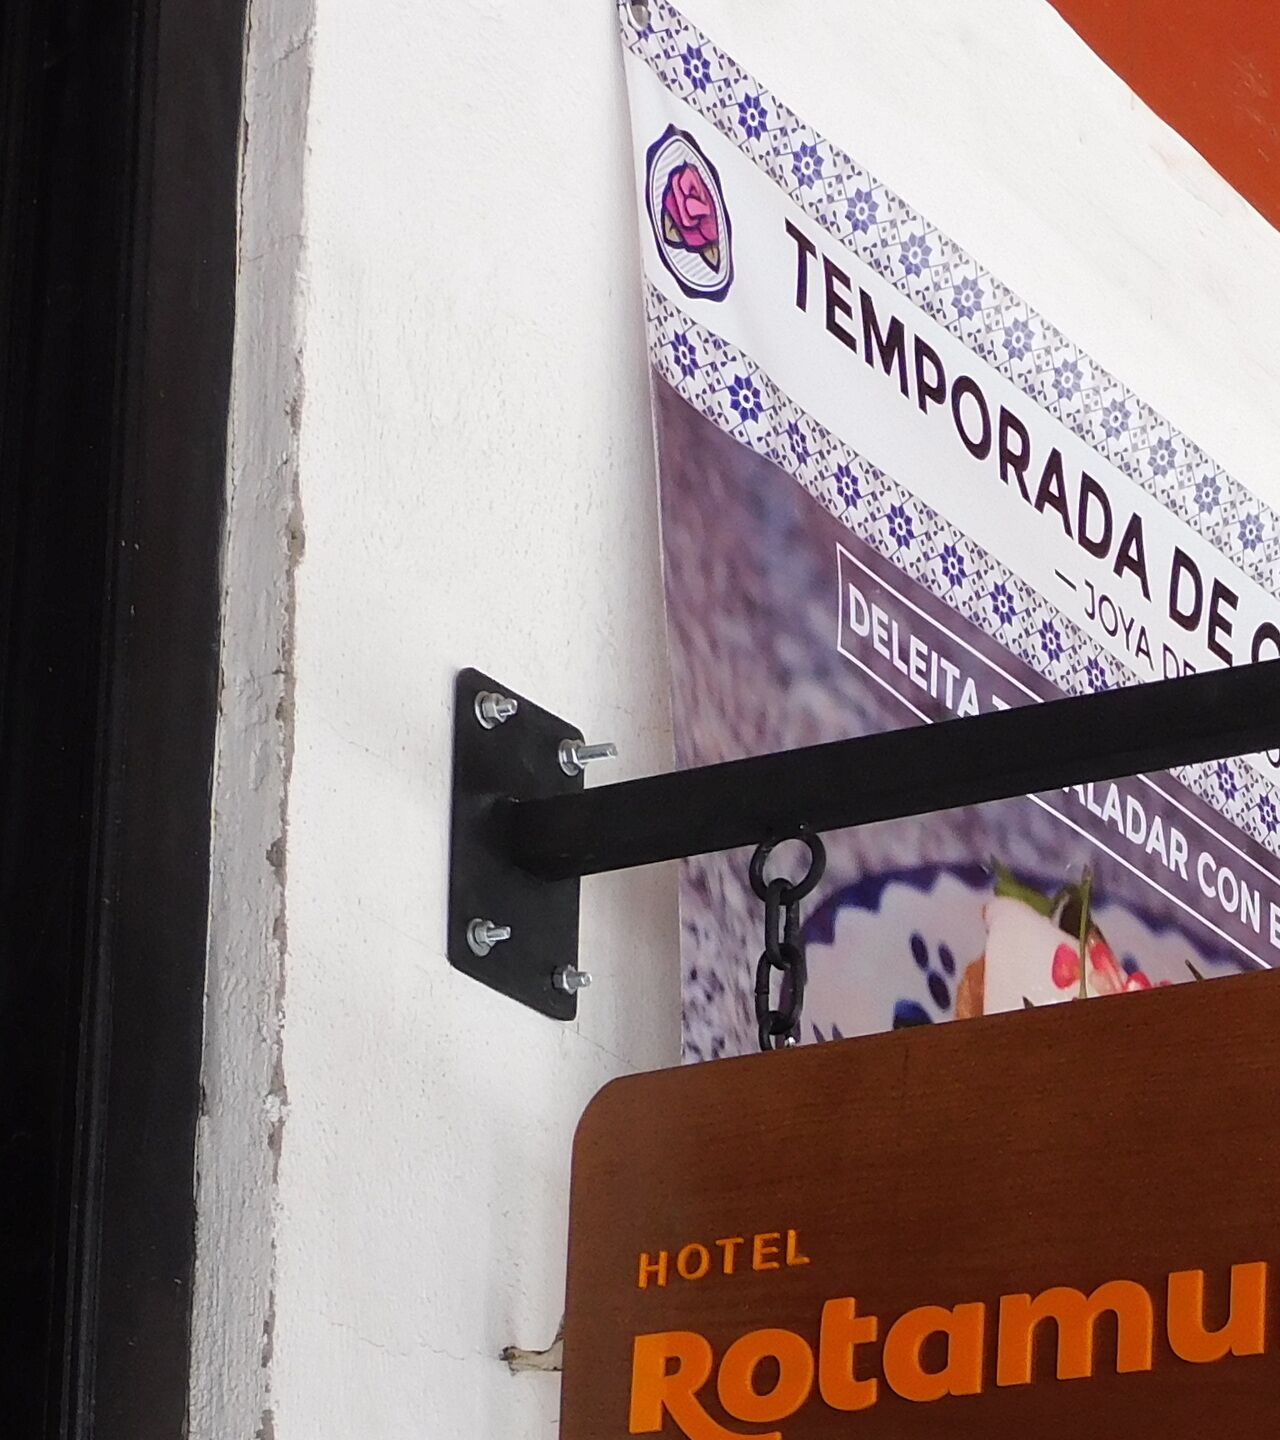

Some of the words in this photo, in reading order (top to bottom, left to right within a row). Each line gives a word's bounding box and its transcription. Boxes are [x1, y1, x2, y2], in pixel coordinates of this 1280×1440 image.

[785, 217, 1152, 602] TEMPORADA
[1168, 545, 1239, 667] DE
[848, 582, 980, 718] DELEITA
[1197, 851, 1261, 935] CON
[636, 1228, 811, 1290] HOTEL
